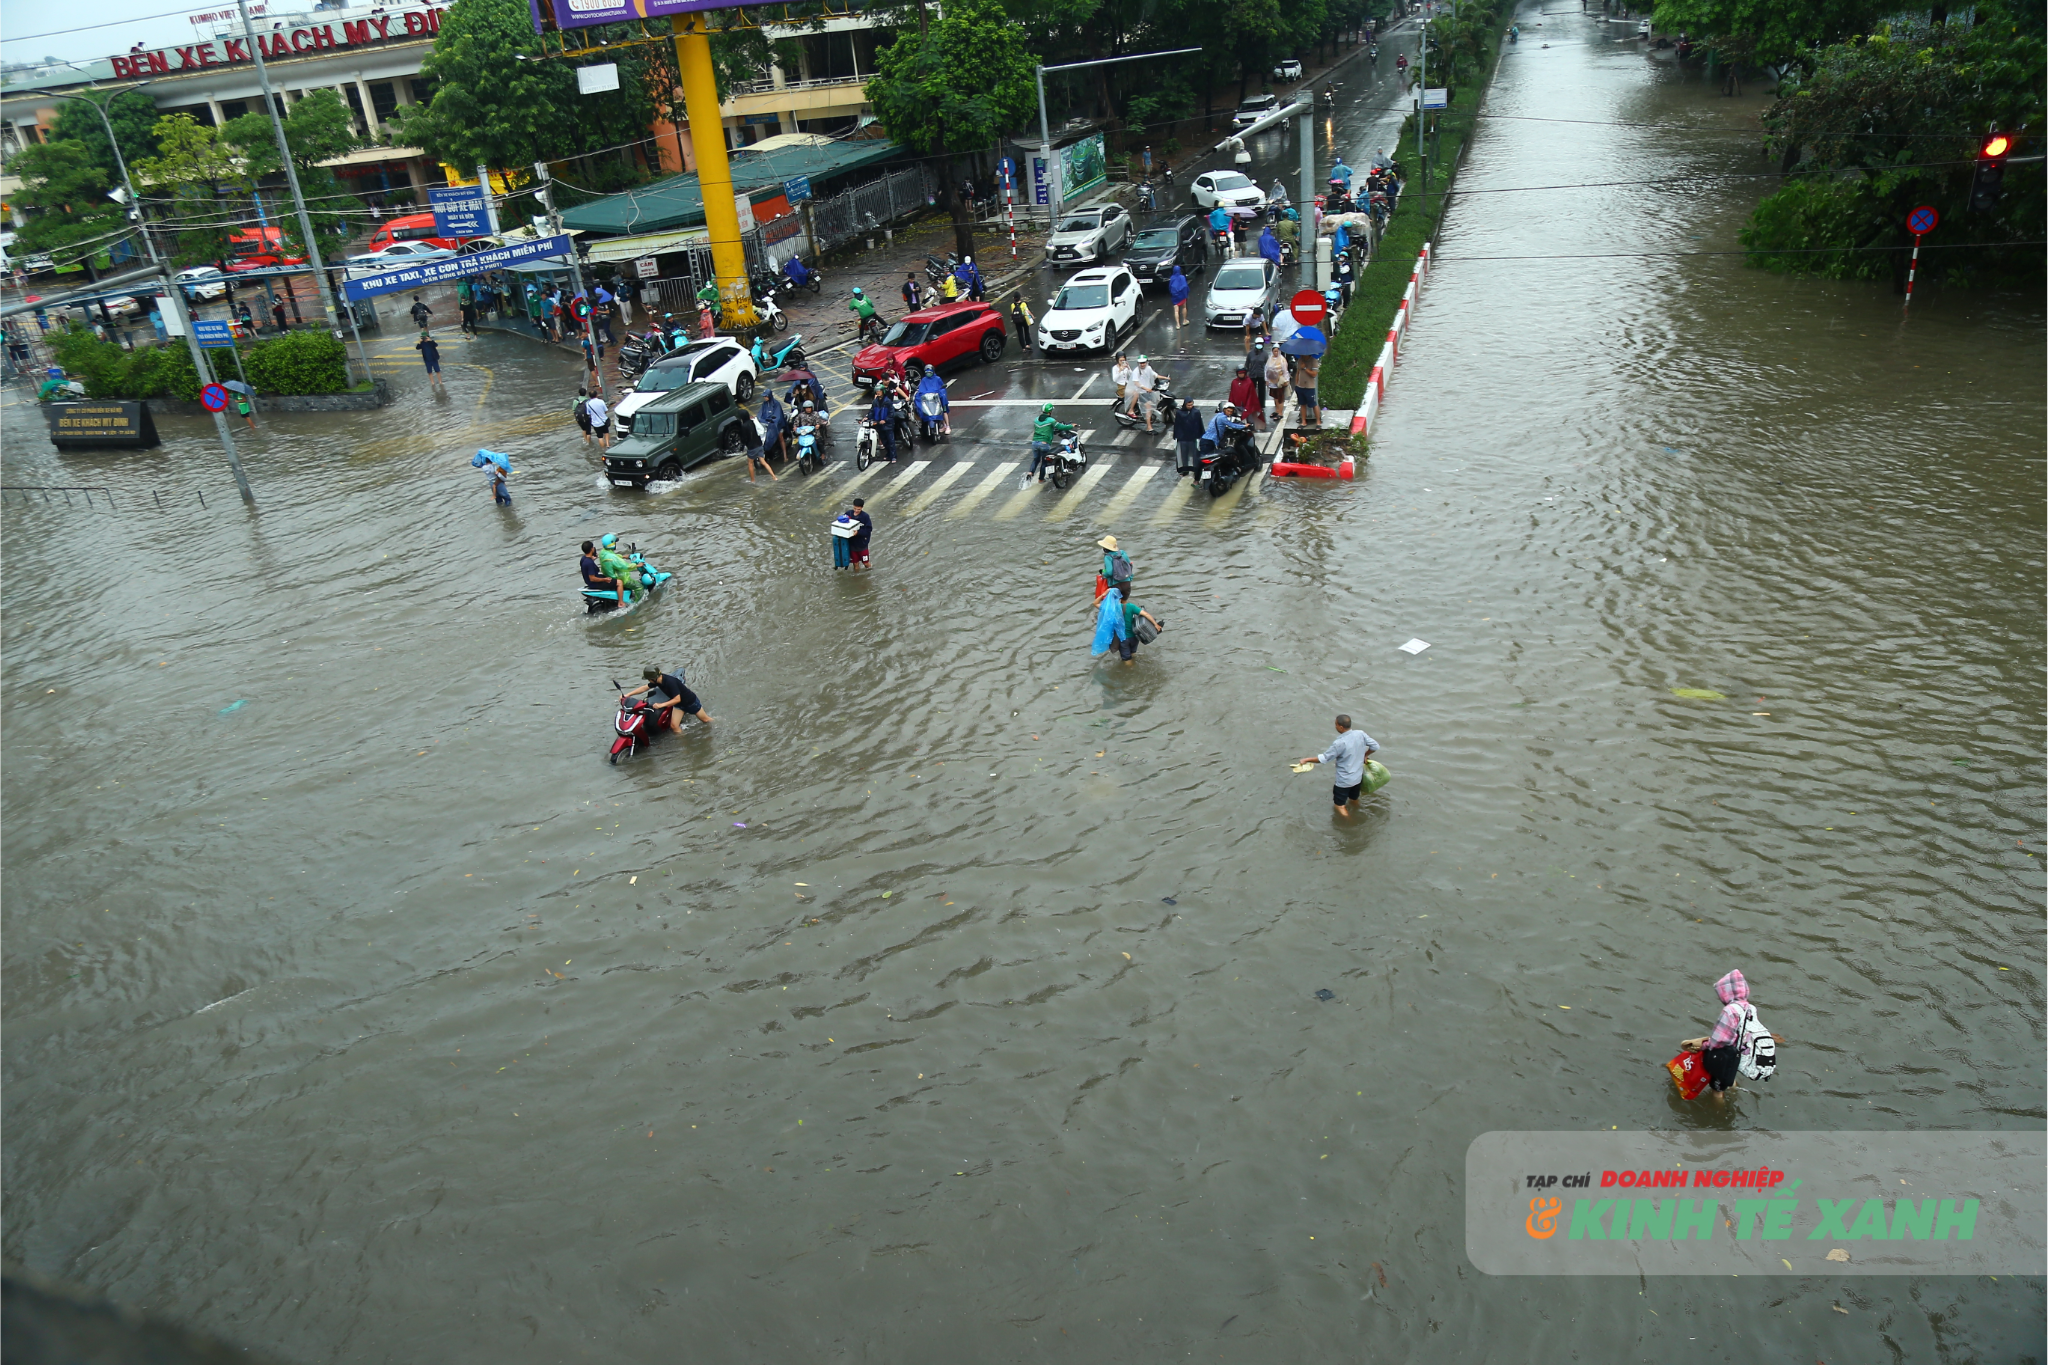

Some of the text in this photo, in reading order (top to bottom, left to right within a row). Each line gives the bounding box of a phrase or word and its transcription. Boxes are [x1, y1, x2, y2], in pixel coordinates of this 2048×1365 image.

[111, 42, 170, 79] BẾN
[175, 43, 219, 71] XE
[224, 22, 336, 63] KHÁCH
[343, 8, 390, 45] MỸ
[189, 12, 218, 25] KUMHO
[362, 240, 553, 290] KHU XE TAXI, XE CON TRẢ KHÁCH MIỄN PHÍ
